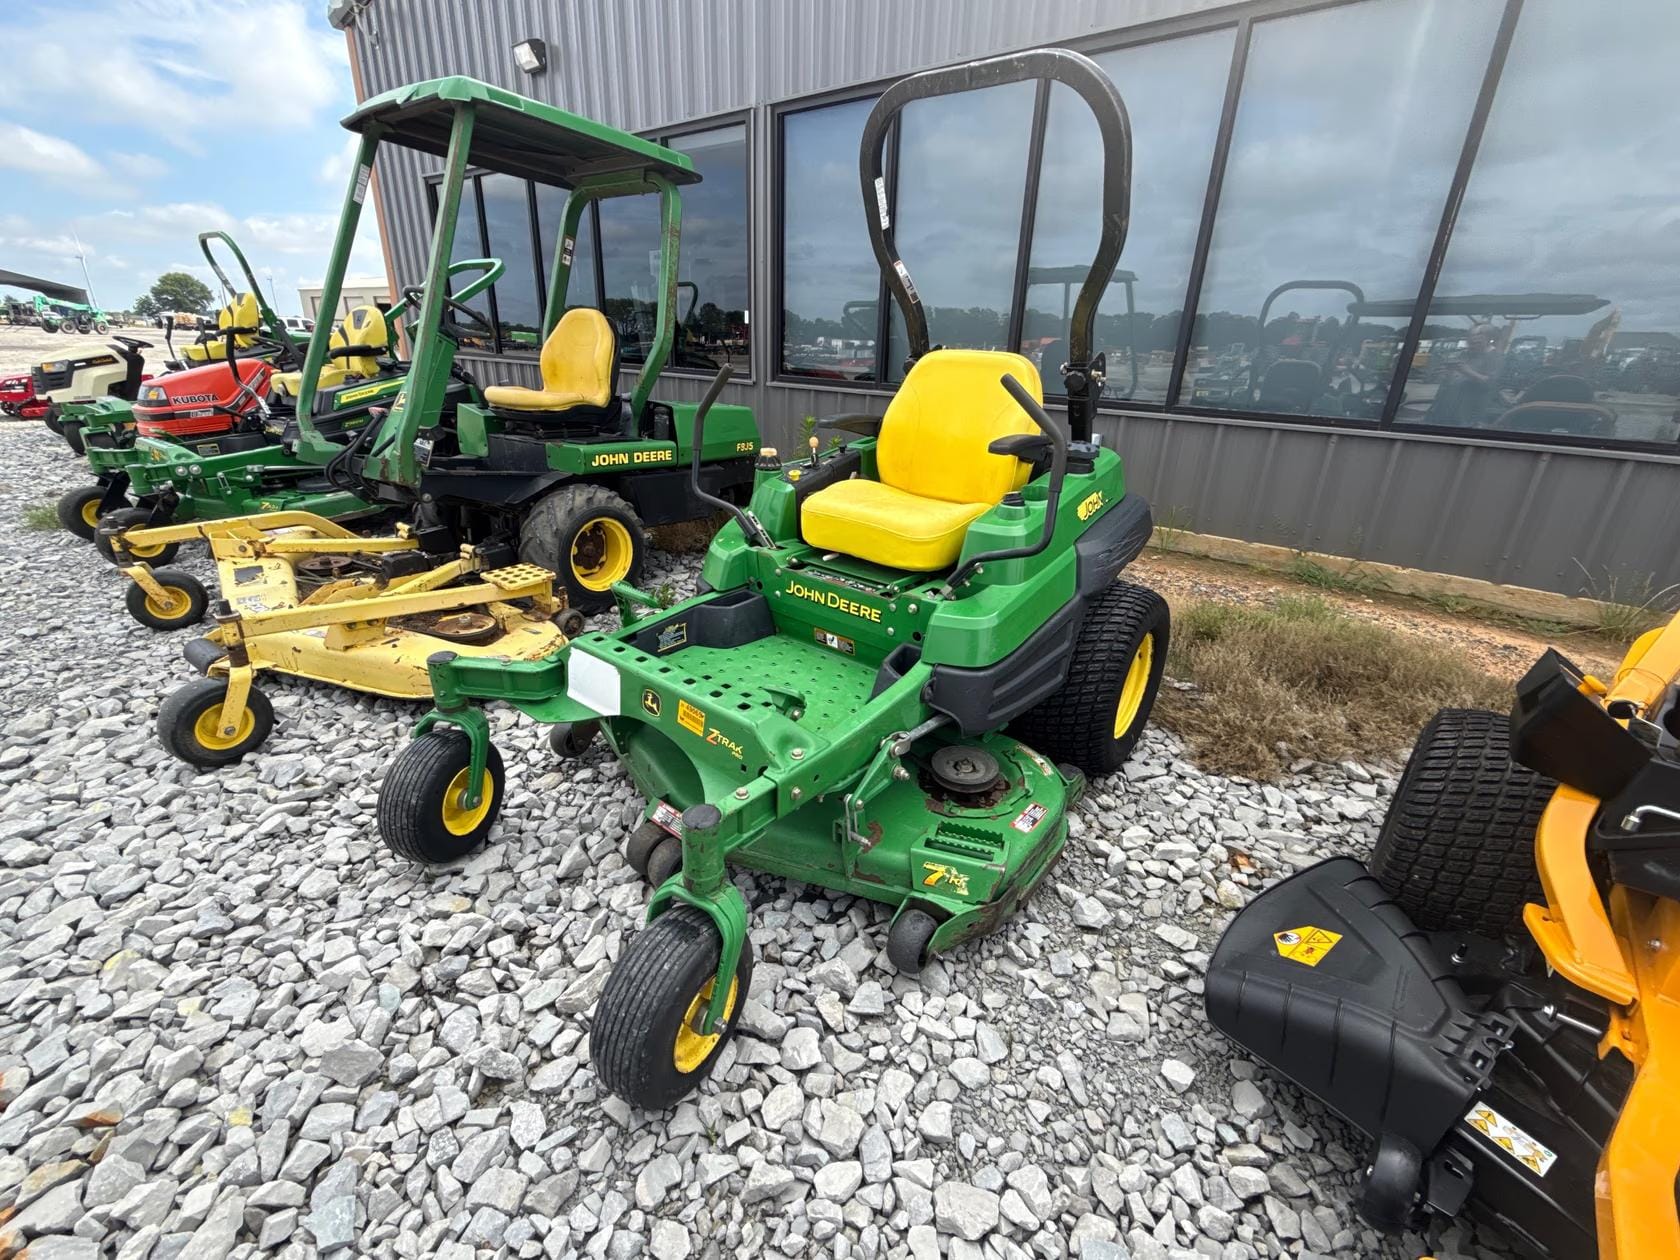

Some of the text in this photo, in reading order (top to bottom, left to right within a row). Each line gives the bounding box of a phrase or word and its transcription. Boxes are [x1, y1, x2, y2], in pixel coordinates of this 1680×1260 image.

[171, 394, 220, 405] KUBOTA
[591, 450, 673, 467] JOHN DEERE
[785, 580, 825, 605] JOHN
[827, 592, 882, 623] DEERE
